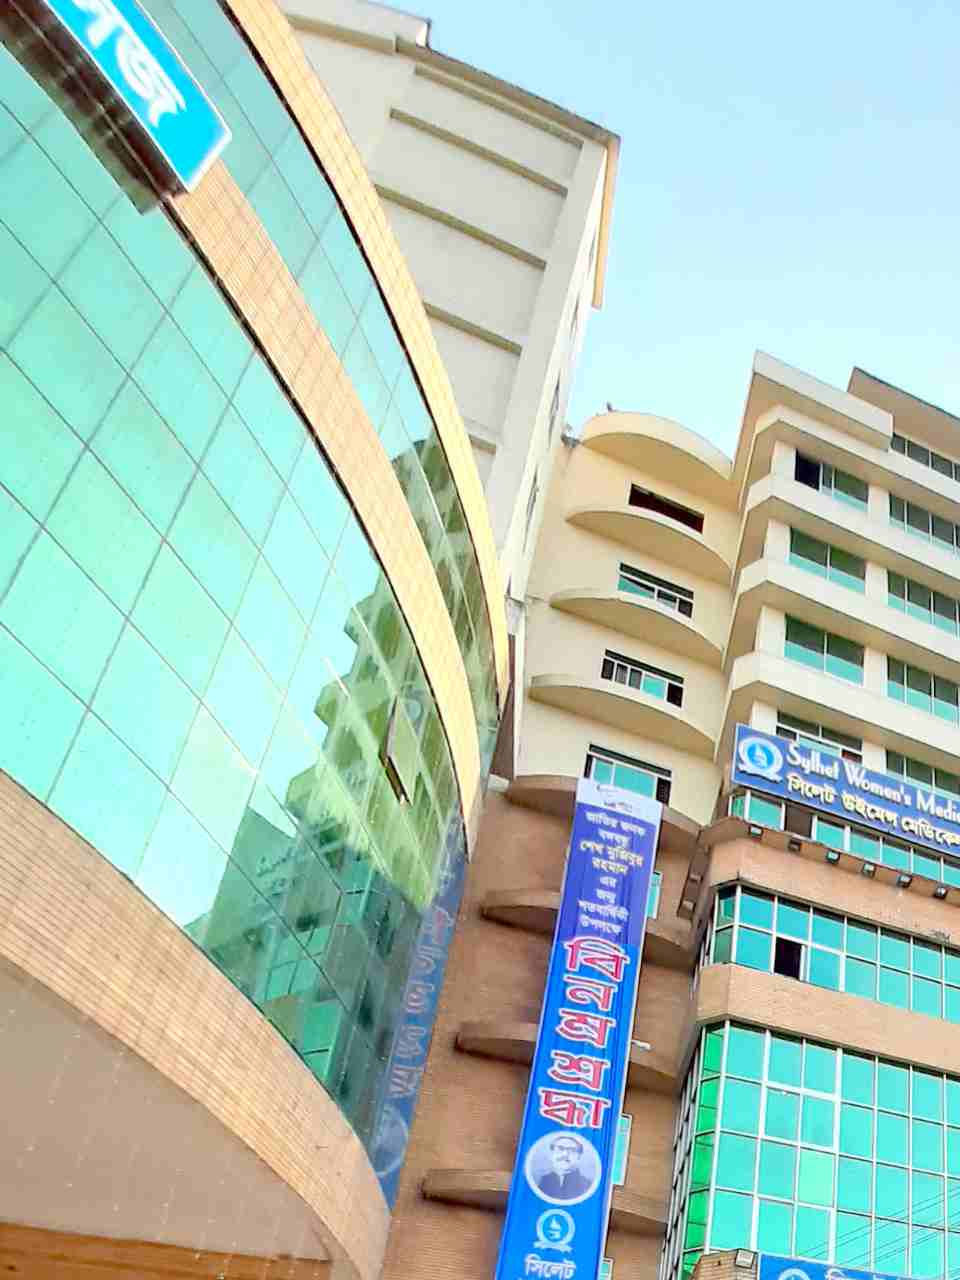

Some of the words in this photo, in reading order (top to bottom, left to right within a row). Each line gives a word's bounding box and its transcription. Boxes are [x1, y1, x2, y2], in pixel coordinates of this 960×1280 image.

[787, 743, 840, 776] Sylhet
[845, 763, 912, 806] Women's
[787, 772, 836, 805] সিলেট
[525, 1252, 577, 1280] সিলেট
